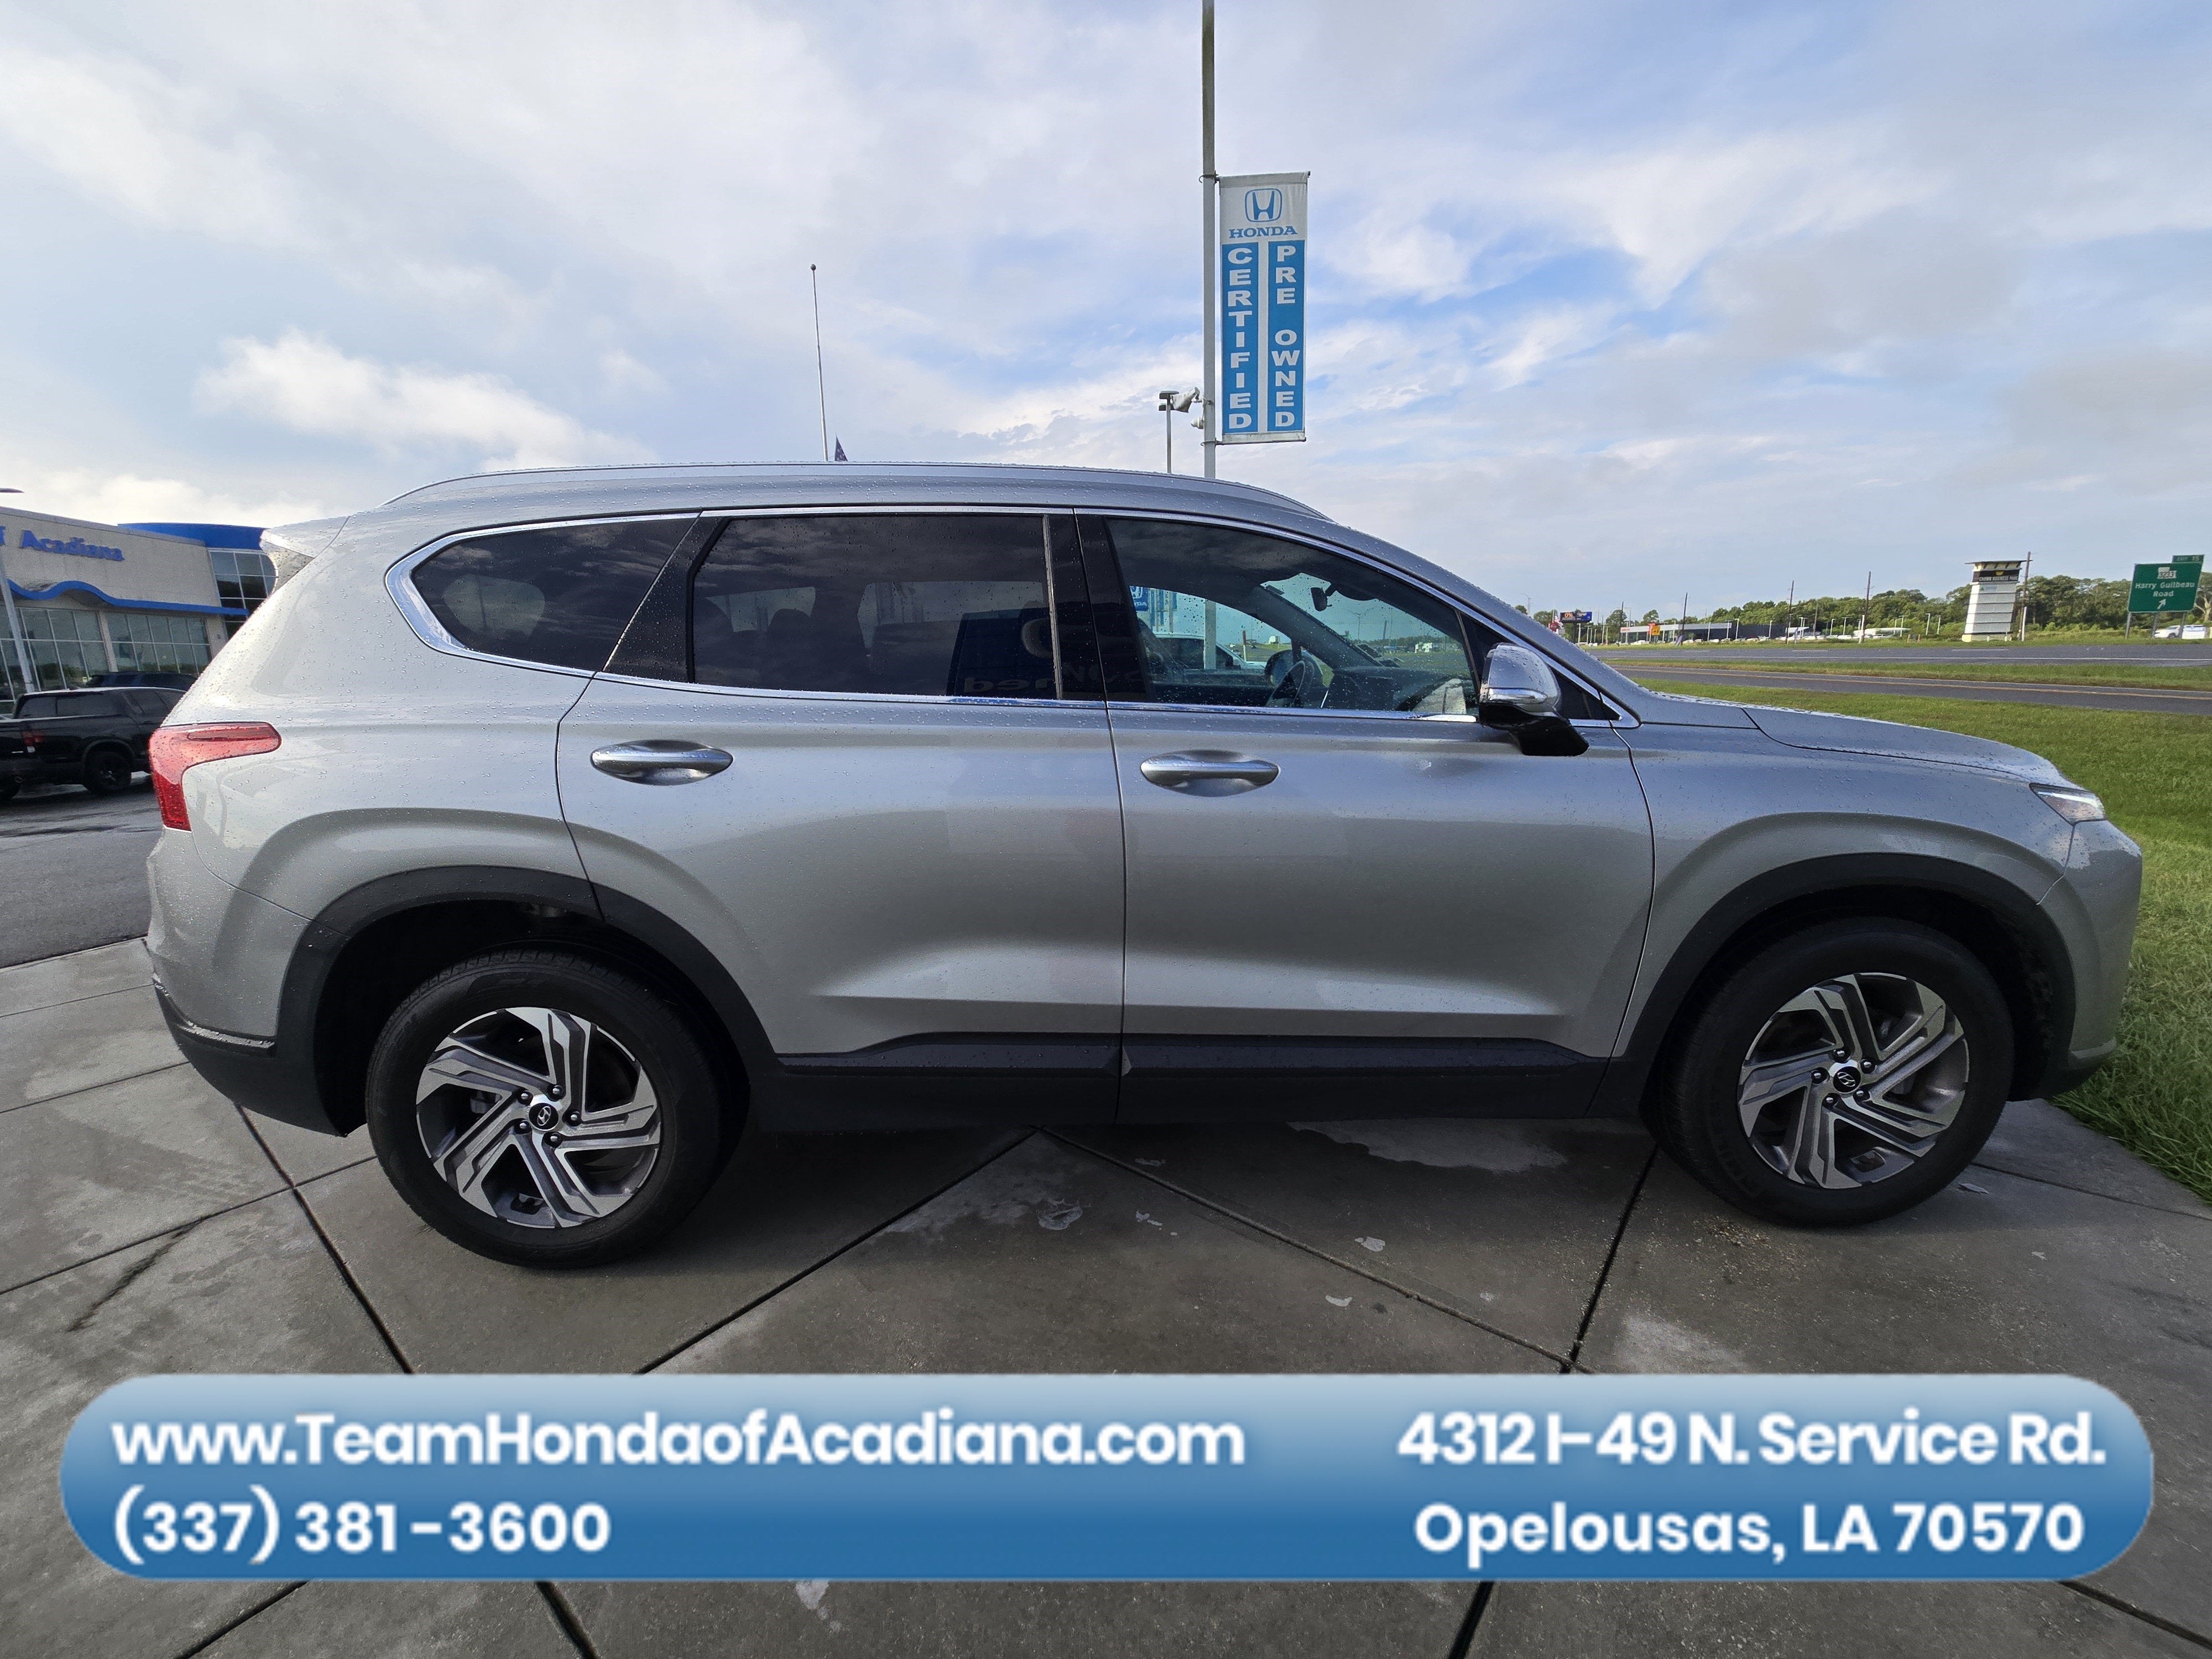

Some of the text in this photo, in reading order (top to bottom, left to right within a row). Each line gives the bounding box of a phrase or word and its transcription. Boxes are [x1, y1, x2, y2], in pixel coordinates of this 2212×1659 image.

[1228, 225, 1298, 239] HONDA
[1227, 247, 1253, 430] CERTIFIED
[1271, 245, 1301, 428] PRE OWNED
[21, 529, 124, 561] Acadiana
